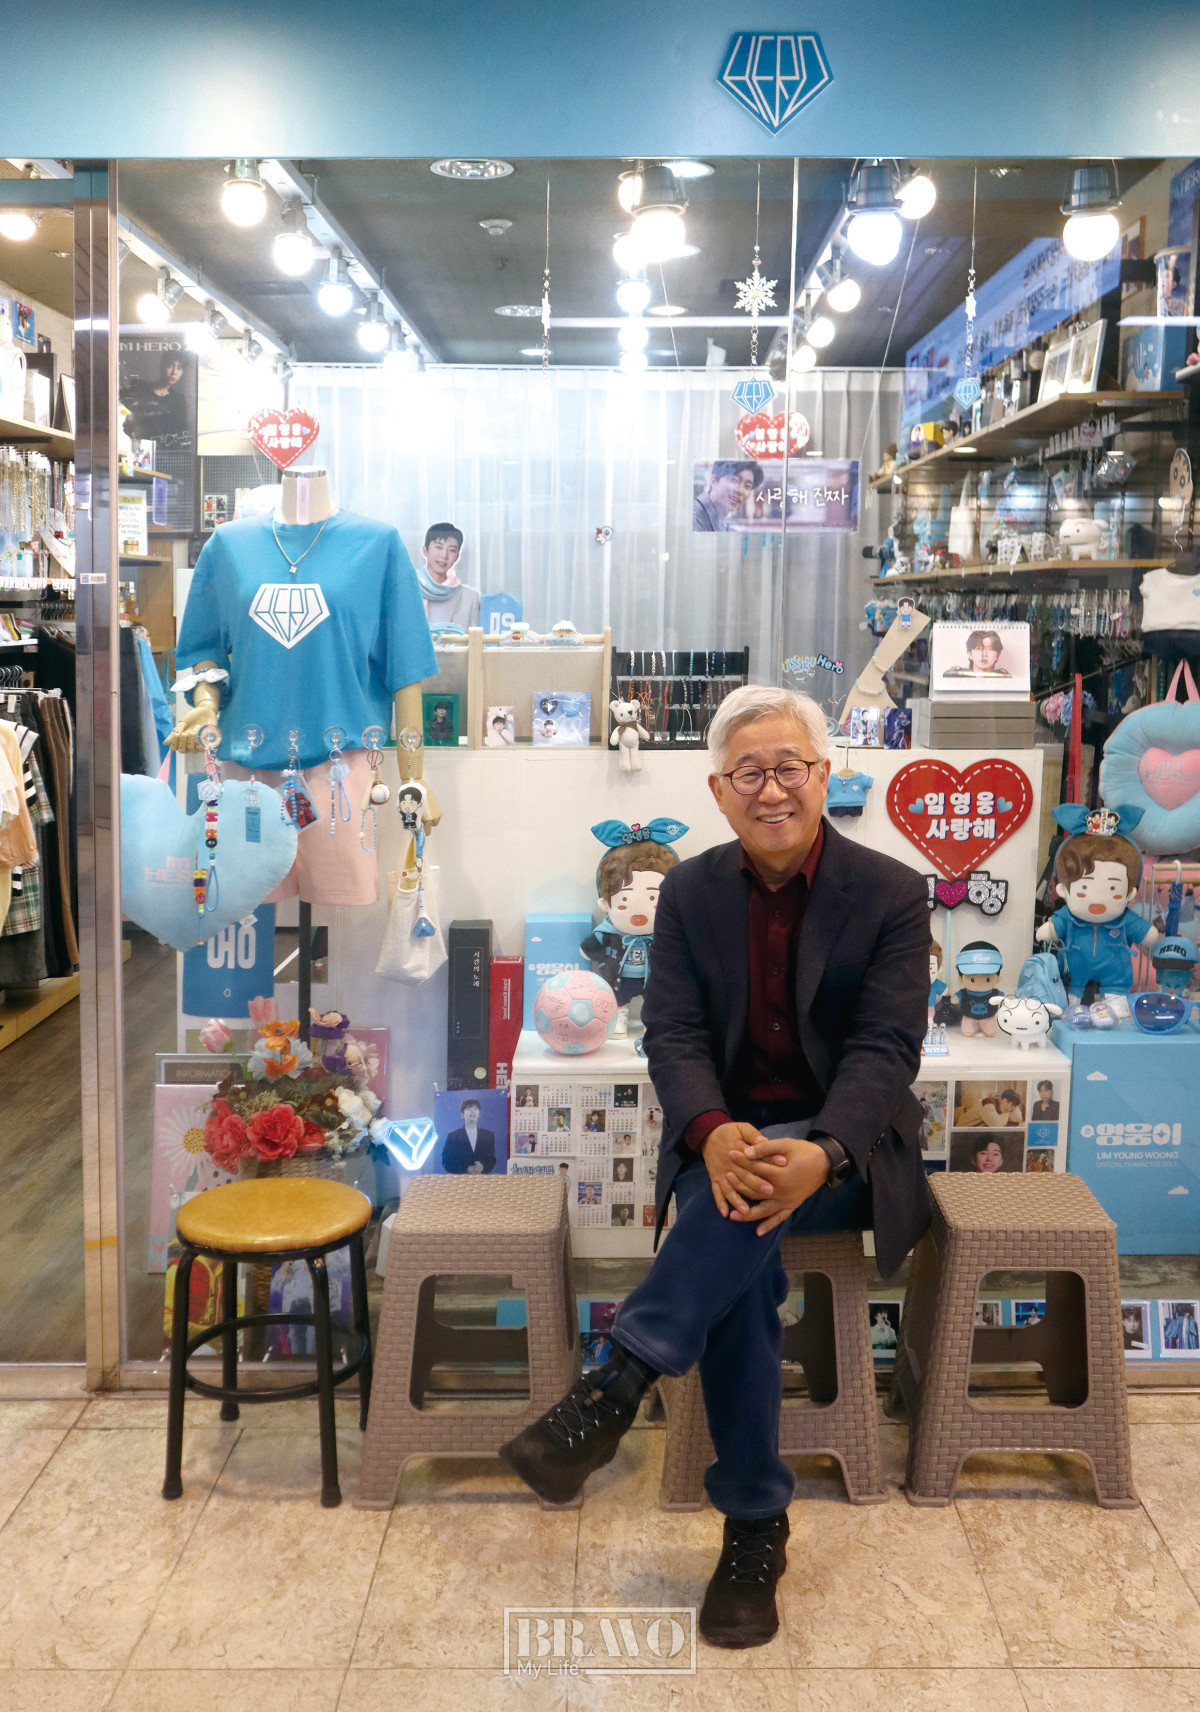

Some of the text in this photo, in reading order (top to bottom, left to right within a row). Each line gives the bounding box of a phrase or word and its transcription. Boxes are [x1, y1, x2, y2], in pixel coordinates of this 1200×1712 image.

[817, 654, 844, 674] Hero
[923, 790, 995, 816] 임영웅
[925, 817, 997, 841] 사랑해
[165, 856, 190, 869] IM
[1159, 944, 1187, 957] HERO
[175, 1069, 237, 1079] INFORMATIO
[495, 1062, 508, 1089] HE
[1095, 1123, 1182, 1146] 영웅이
[1096, 1151, 1179, 1160] LIM YOUNG WOONG
